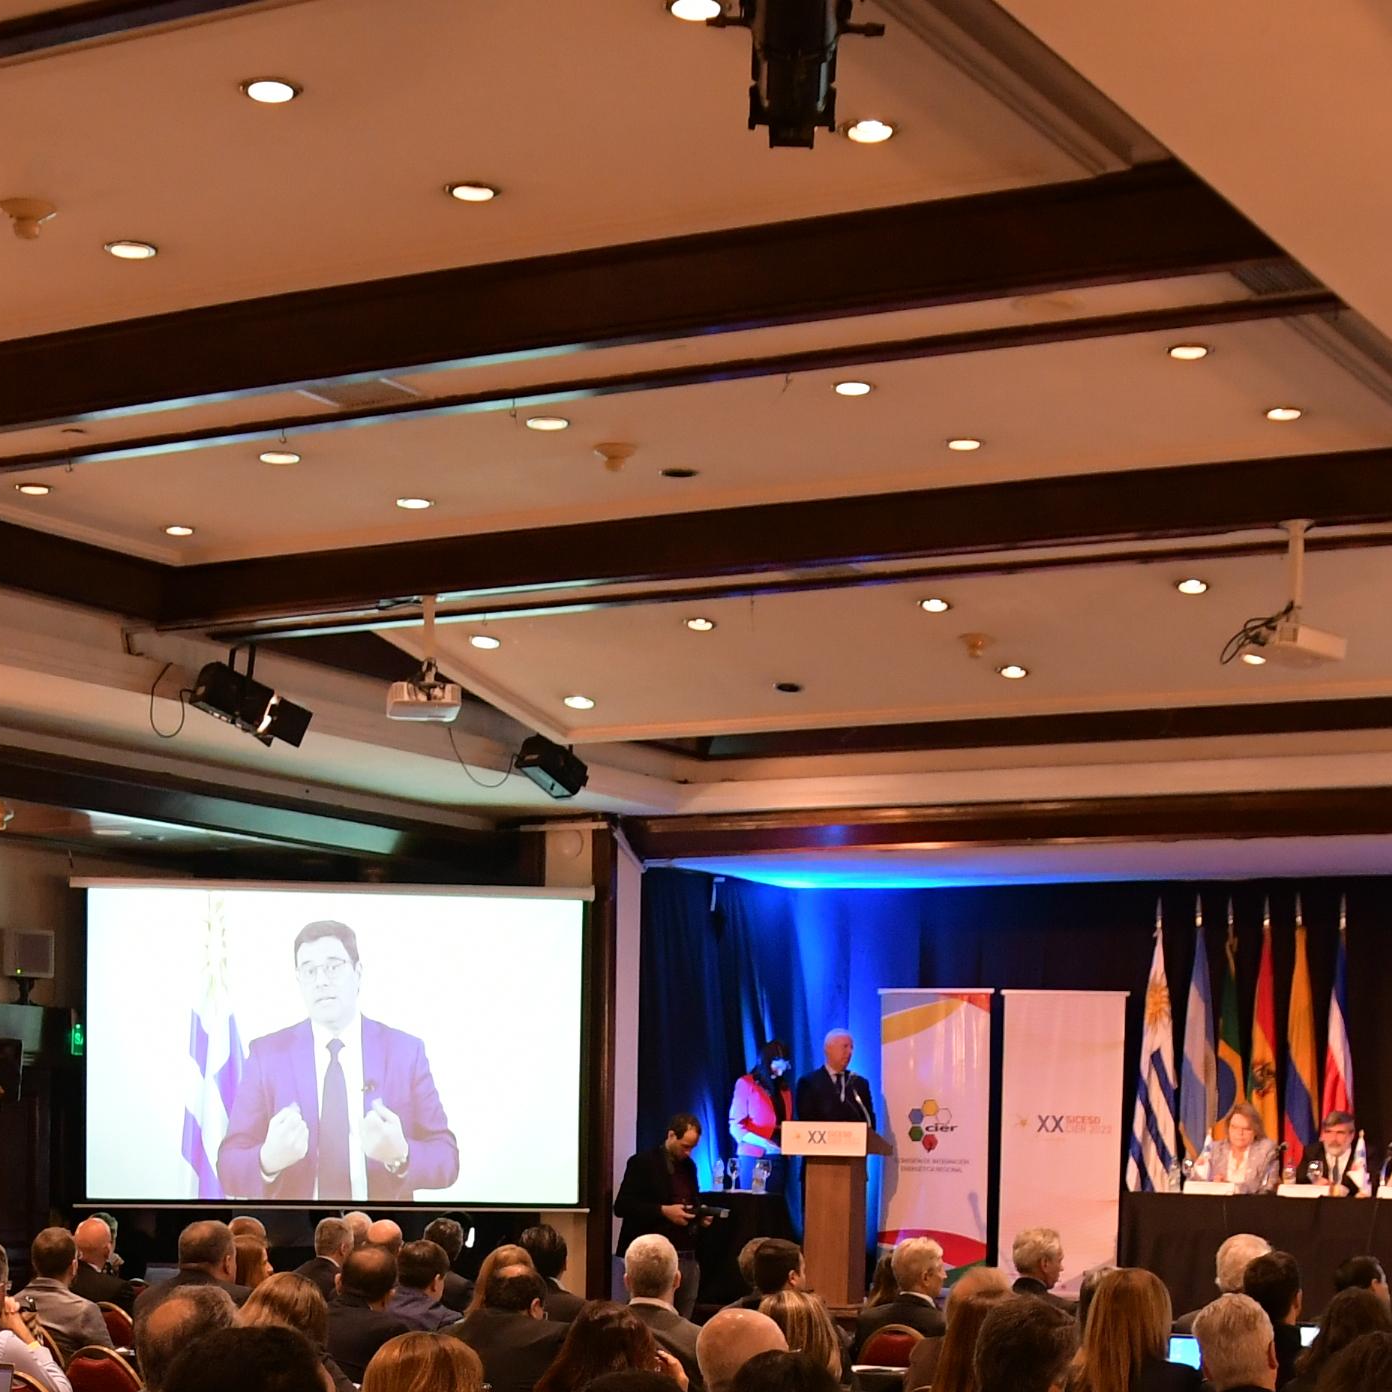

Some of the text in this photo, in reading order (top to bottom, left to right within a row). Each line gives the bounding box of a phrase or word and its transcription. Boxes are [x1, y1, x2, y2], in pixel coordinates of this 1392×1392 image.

[925, 1123, 958, 1132] cier
[1037, 1115, 1064, 1132] XX
[808, 1130, 826, 1144] XX
